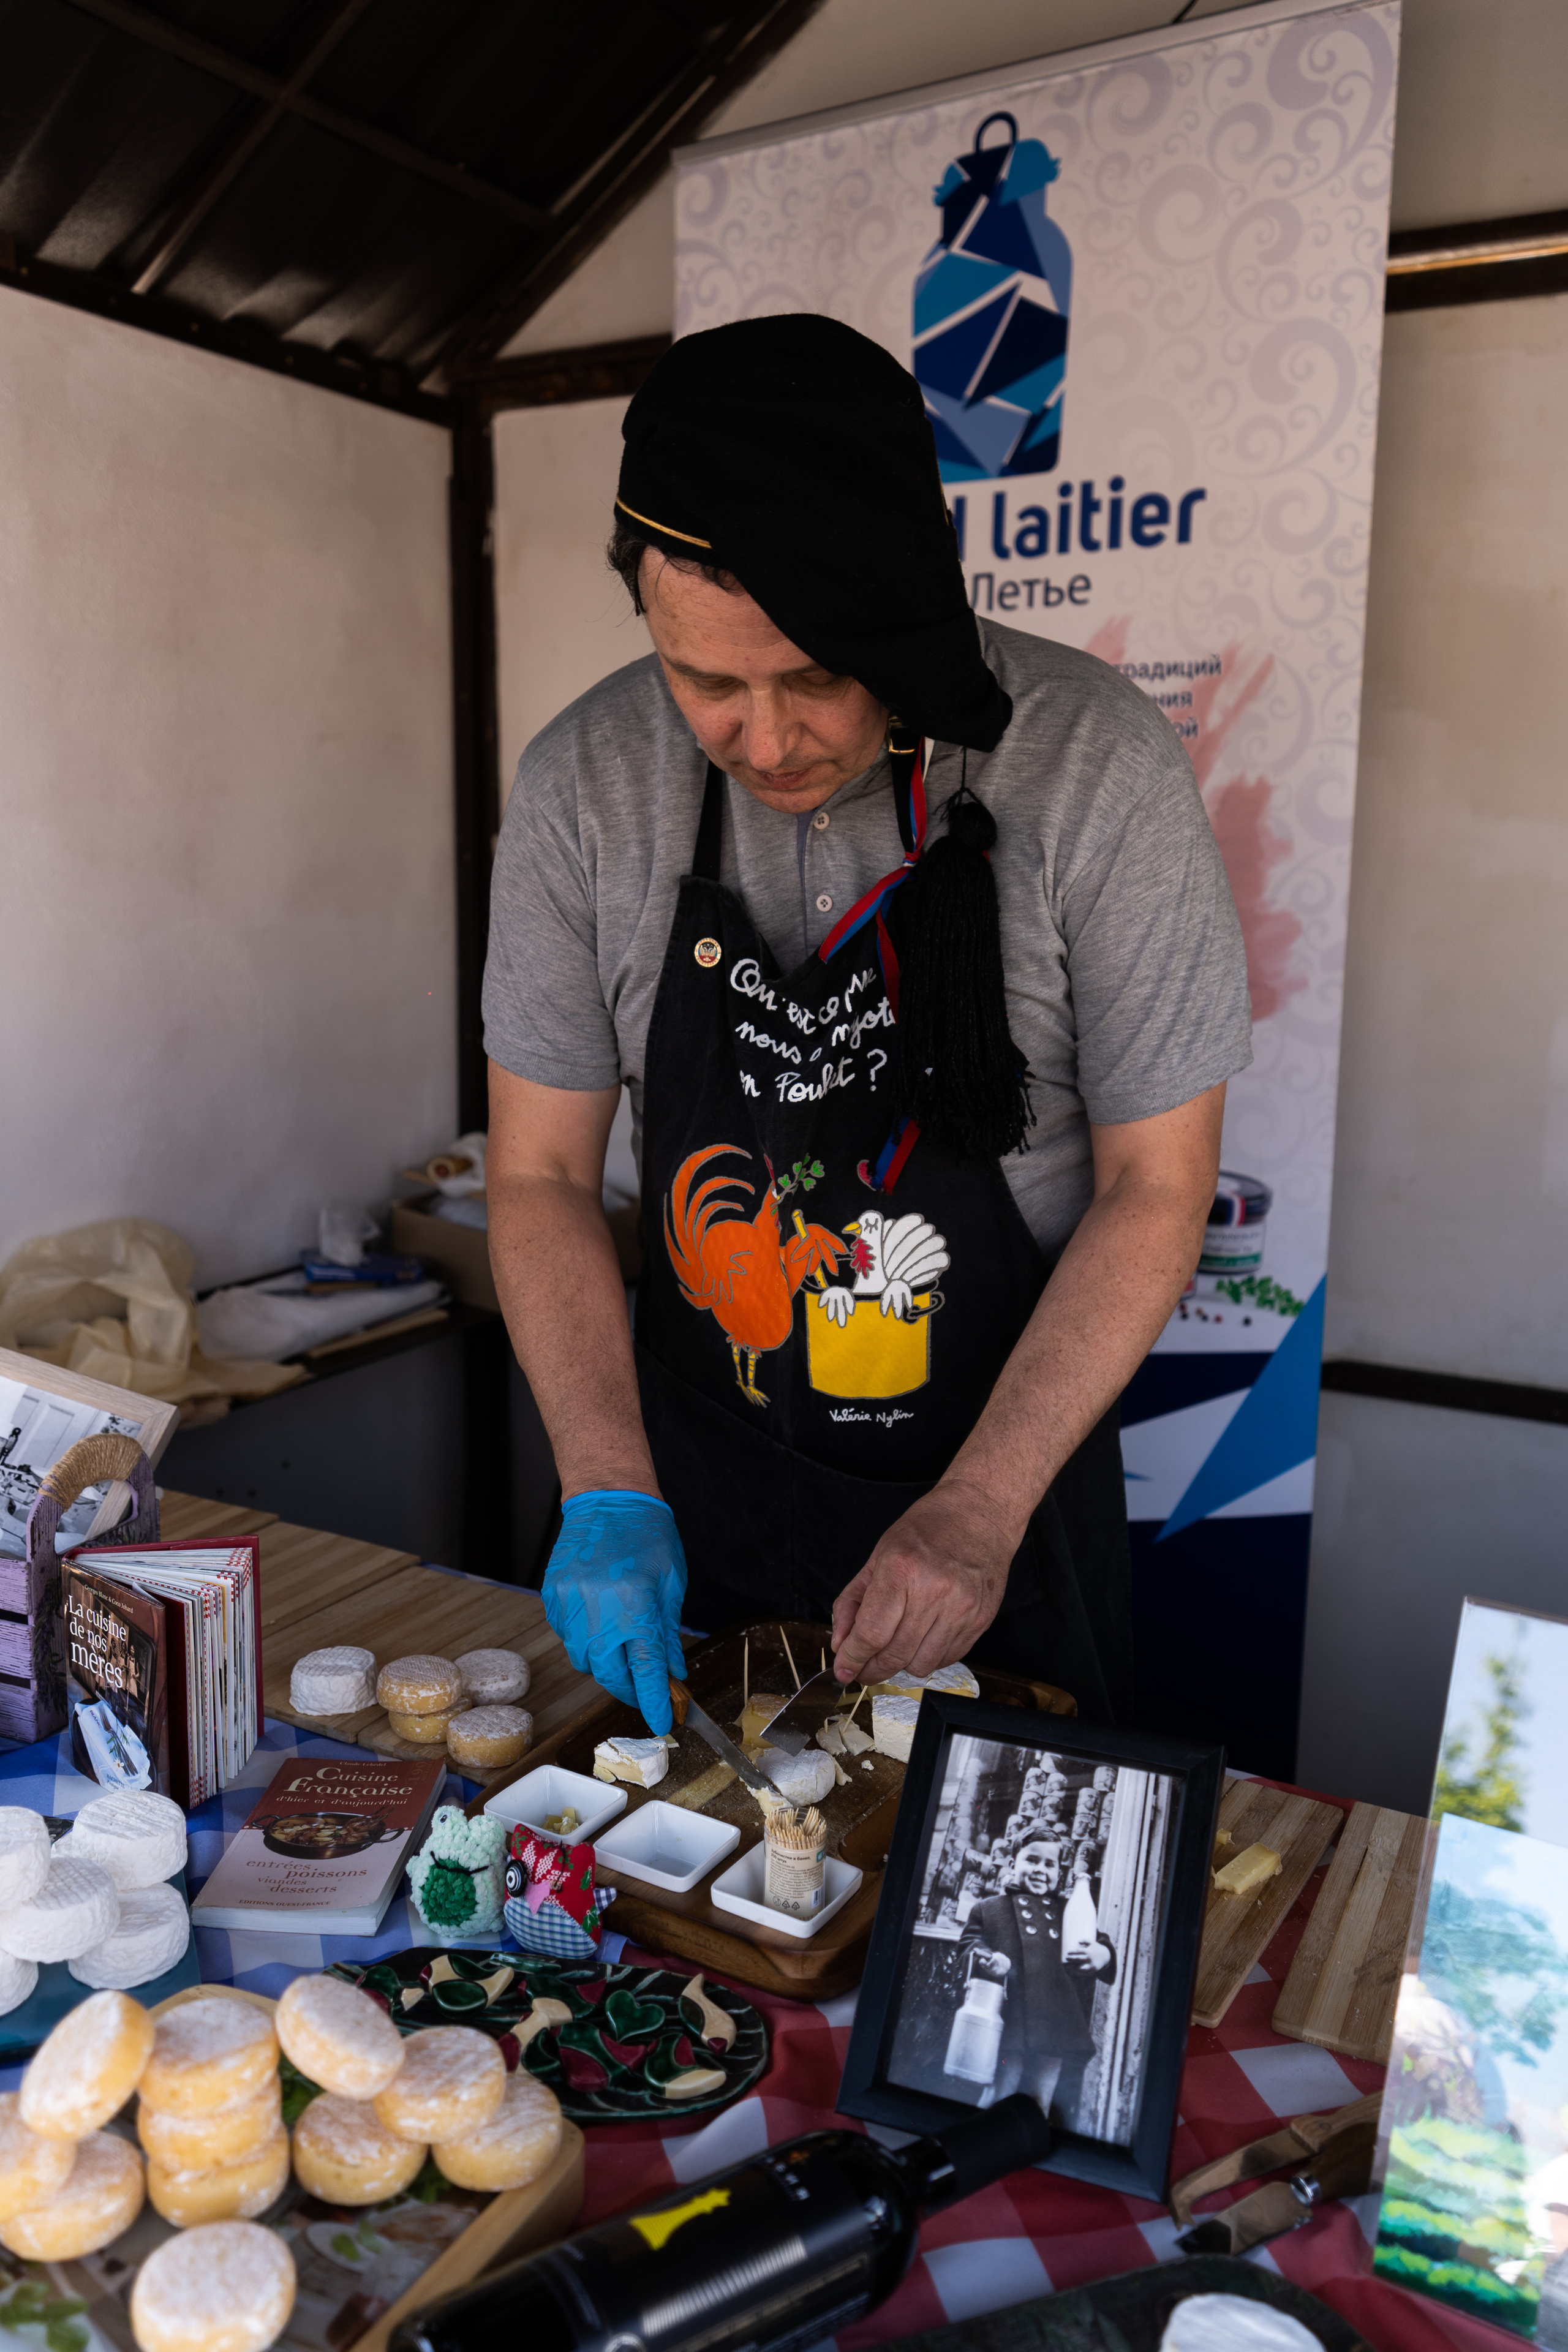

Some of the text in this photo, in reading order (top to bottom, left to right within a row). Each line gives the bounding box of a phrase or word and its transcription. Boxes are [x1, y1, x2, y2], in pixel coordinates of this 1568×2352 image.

[992, 476, 1207, 560] laitier
[970, 573, 1092, 612] Летье
[735, 1021, 802, 1065] nous
[867, 1048, 888, 1092] ?
[85, 1584, 99, 1596] Georges
[98, 1590, 108, 1601] Blanc
[68, 1594, 127, 1642] La cuisine
[69, 1617, 107, 1653] de nos
[70, 1642, 123, 1689] mères
[316, 1766, 399, 1782] Cuisine
[331, 1798, 409, 1807] d'aujourd'hui
[246, 1861, 312, 1870] entrées
[285, 1868, 368, 1879] poissons
[258, 1876, 307, 1885] viandes
[270, 1885, 337, 1894] desserts
